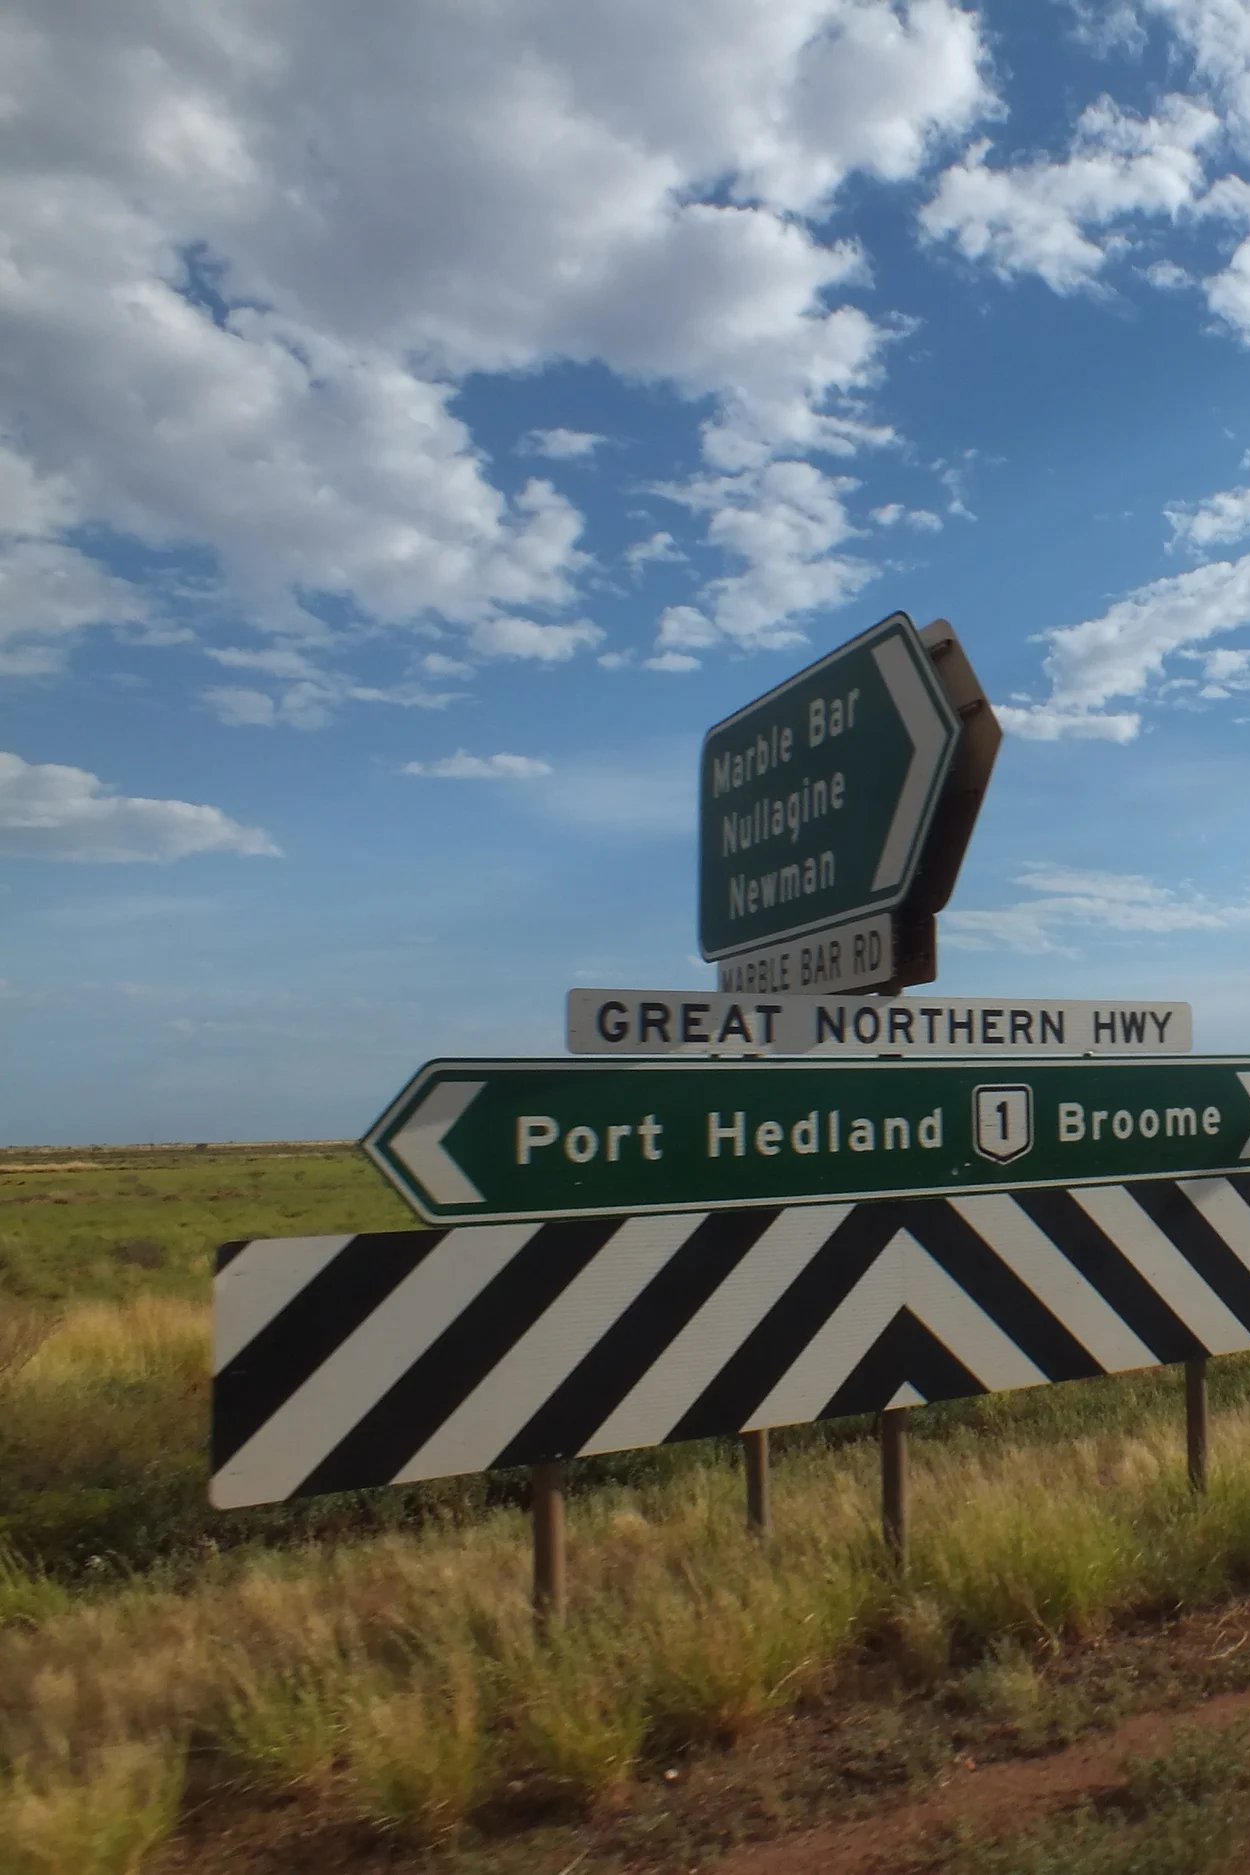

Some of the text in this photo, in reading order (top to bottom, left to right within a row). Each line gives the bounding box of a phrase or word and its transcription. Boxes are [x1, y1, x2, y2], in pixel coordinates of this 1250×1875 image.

[713, 687, 860, 798] Marble Bar
[722, 771, 845, 857] Nullagine
[729, 850, 835, 920] Newman
[802, 940, 842, 985] BAR
[854, 930, 881, 974] RD
[597, 1001, 1173, 1045] GREAT NORTHERN HWY
[516, 1101, 1222, 1165] Port Hedland 1 Broome
